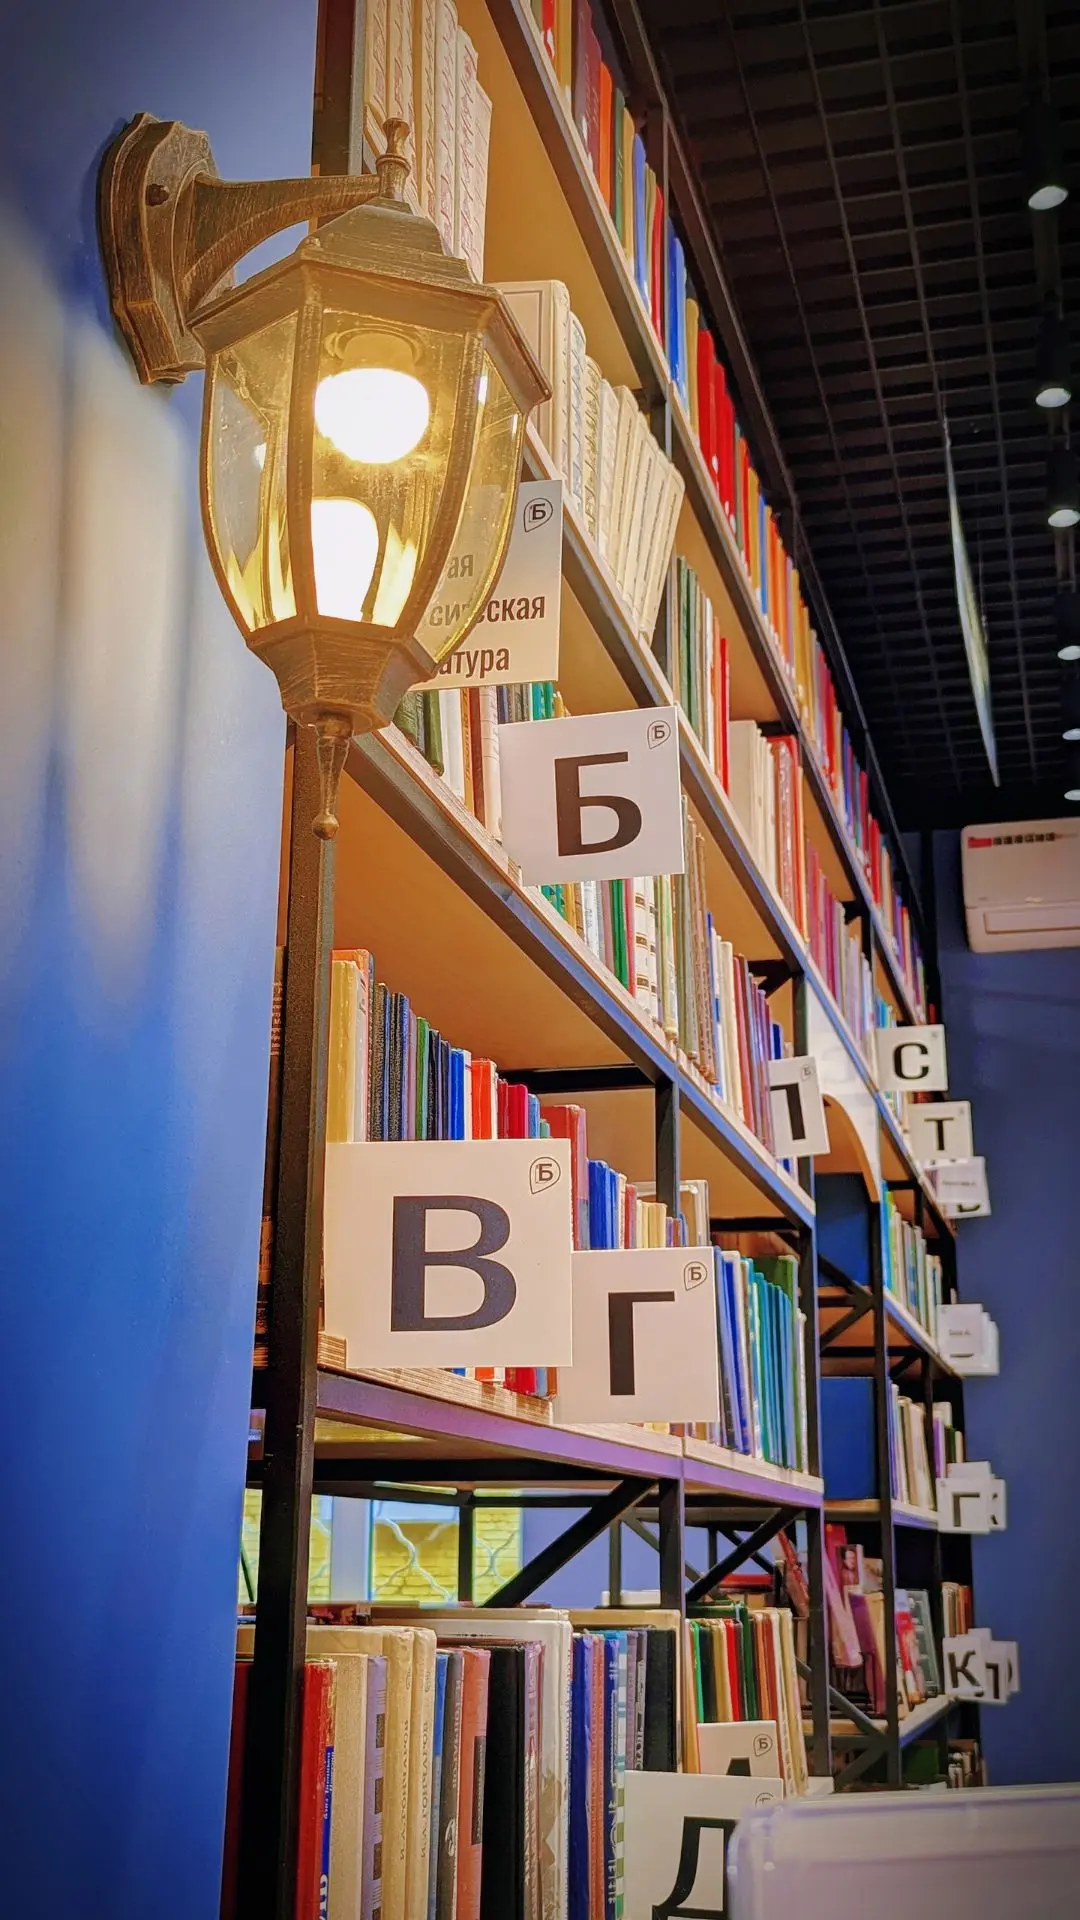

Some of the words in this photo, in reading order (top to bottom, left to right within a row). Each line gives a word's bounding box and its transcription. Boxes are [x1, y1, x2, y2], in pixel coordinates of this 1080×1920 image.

[439, 647, 510, 679] атура
[554, 751, 643, 857] Б
[893, 1042, 929, 1080] С
[924, 1117, 954, 1151] Т
[391, 1195, 517, 1332] В
[608, 1291, 675, 1396] Г
[948, 1650, 980, 1689] К
[652, 1816, 737, 1920] Д
